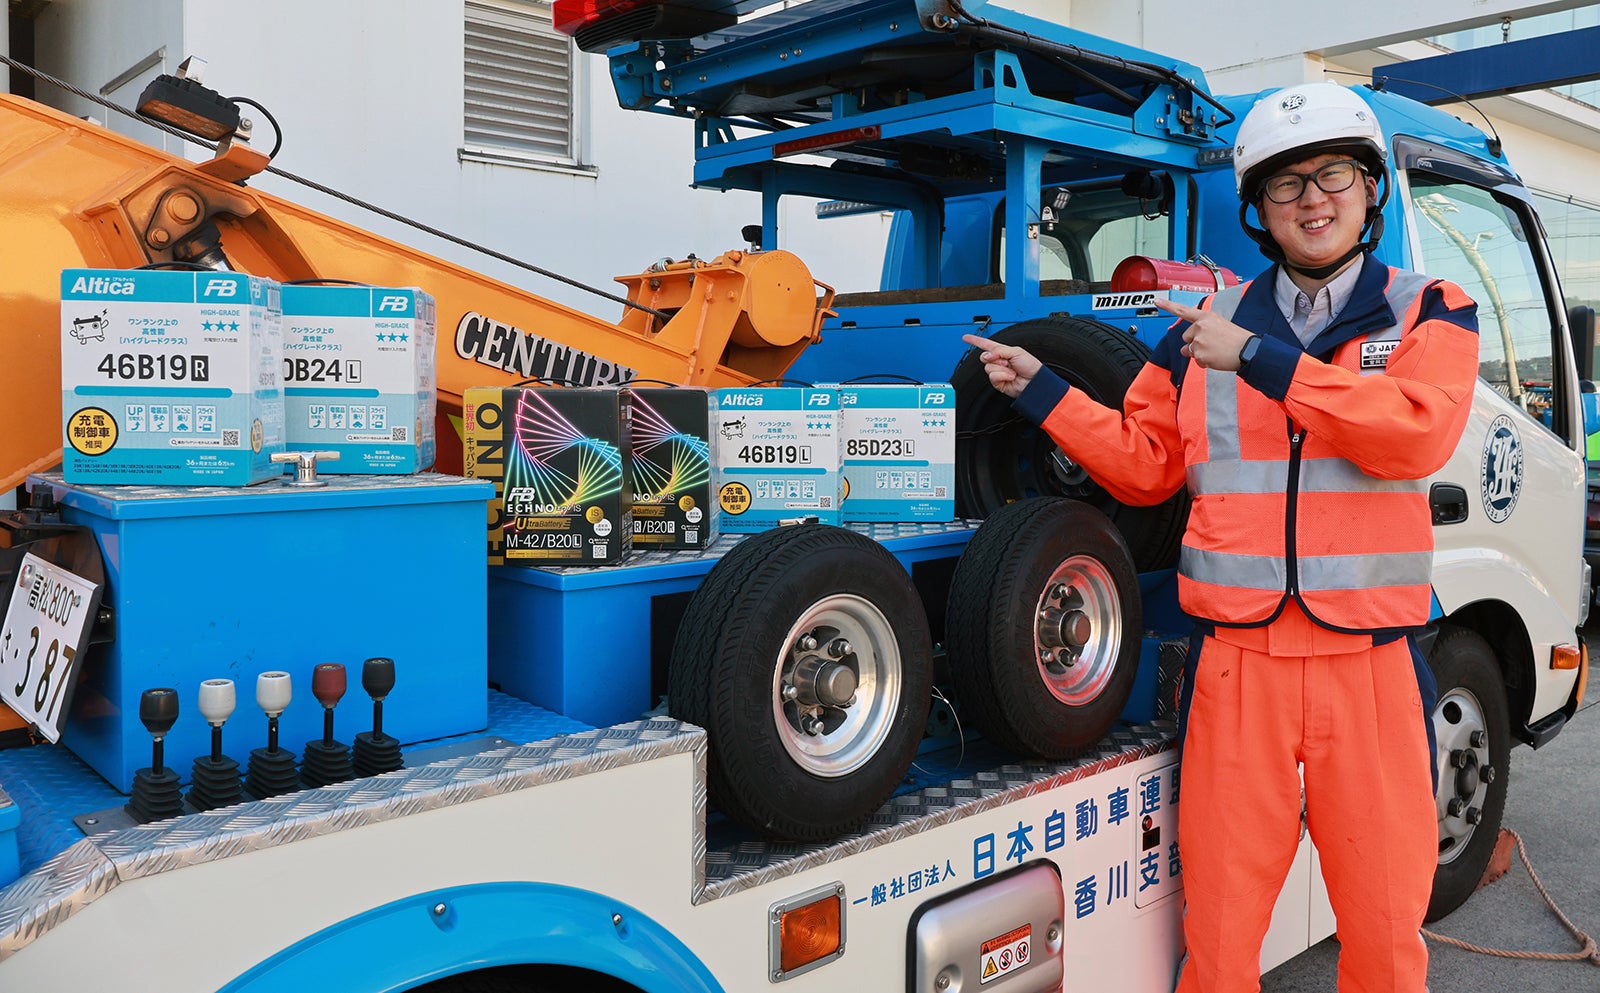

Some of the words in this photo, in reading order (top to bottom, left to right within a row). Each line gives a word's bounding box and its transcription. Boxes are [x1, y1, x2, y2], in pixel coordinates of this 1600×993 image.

[70, 277, 135, 295] Altica
[204, 279, 237, 297] FB
[379, 296, 409, 312] FB
[1095, 294, 1155, 308] miller
[128, 318, 178, 326] ワンランク上の
[455, 311, 638, 387] CENTURY
[722, 394, 763, 406] Altica
[808, 394, 831, 406] FB
[924, 393, 946, 405] FB
[128, 407, 143, 416] UP
[310, 407, 324, 415] UP
[466, 403, 475, 431] 世界初
[79, 415, 104, 426] 充電
[74, 427, 110, 438] 制御車
[508, 487, 535, 502] FB
[726, 487, 743, 495] 充電
[507, 503, 554, 513] ECHNO
[591, 509, 599, 517] IS
[852, 859, 957, 908] 一般社団法人
